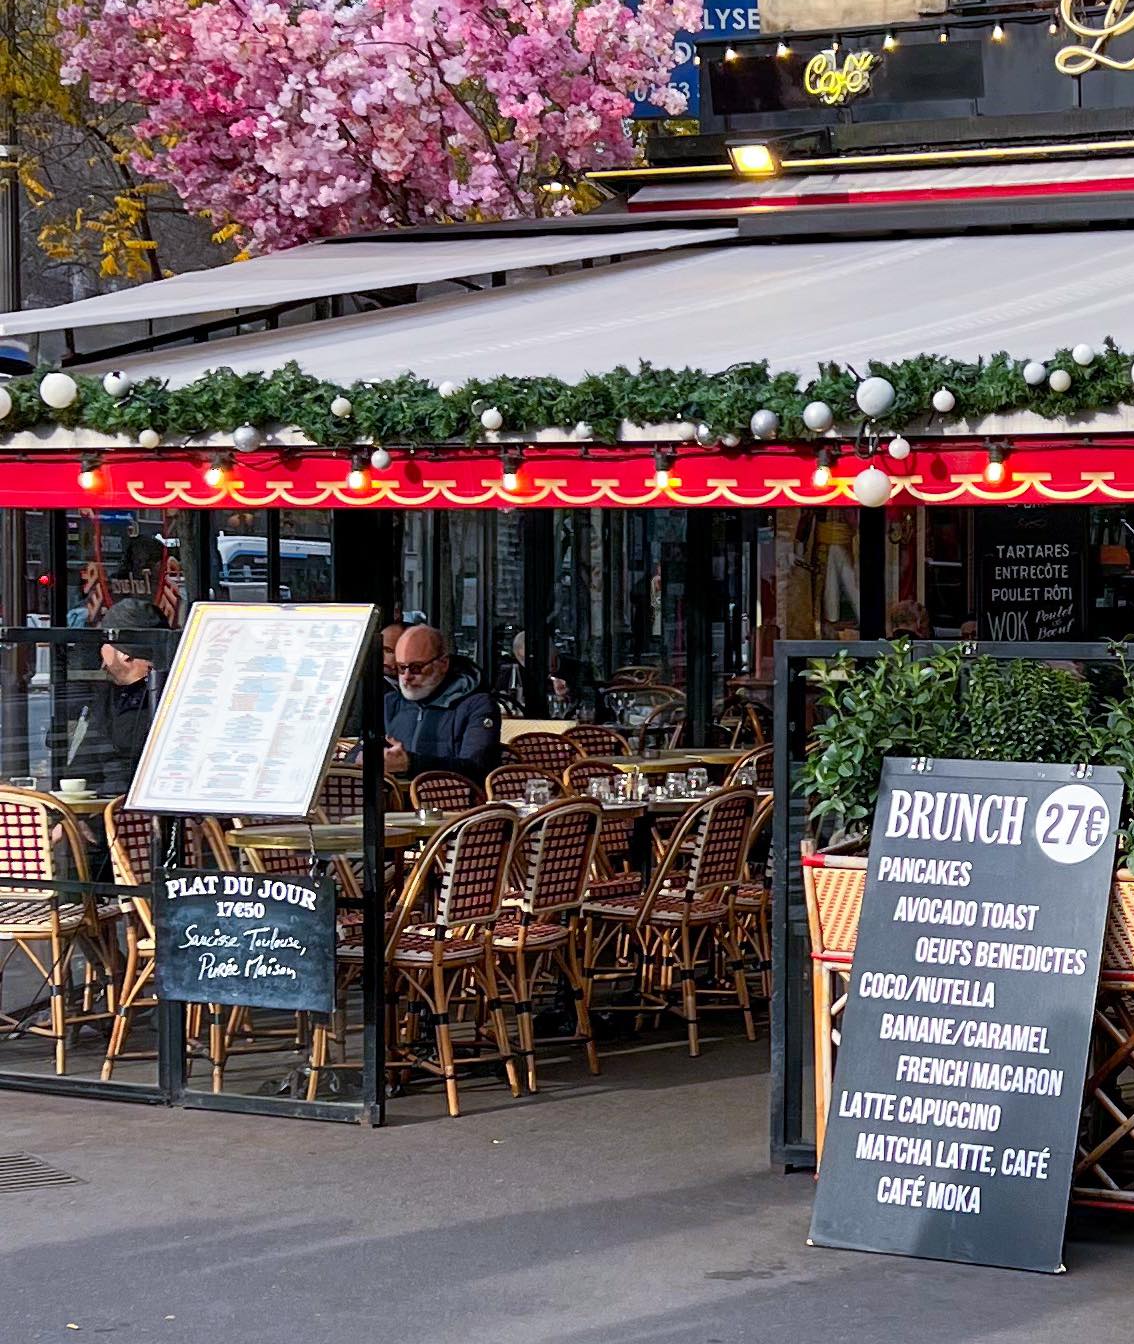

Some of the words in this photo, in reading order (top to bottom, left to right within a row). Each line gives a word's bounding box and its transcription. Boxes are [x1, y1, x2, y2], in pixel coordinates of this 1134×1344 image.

[804, 49, 875, 105] Café
[996, 543, 1070, 559] TARTARES
[994, 562, 1069, 580] ENTRECÔTE
[991, 587, 1040, 602] POULET
[1044, 583, 1073, 601] RÔTI
[987, 609, 1031, 642] WOK
[884, 789, 1029, 846] BRUNCH
[1042, 802, 1107, 847] 27€
[877, 856, 973, 888] PANCAKES
[165, 875, 219, 899] PLAT
[223, 876, 254, 896] DU
[258, 879, 318, 910] JOUR
[215, 901, 266, 918] 17€50
[893, 895, 978, 928] AVOCADO
[981, 901, 1040, 931] TOAST
[244, 954, 297, 980] Maison
[915, 936, 973, 967] OEUFS
[974, 941, 1088, 976] BENEDICTES
[859, 971, 996, 1008] COCO/NUTELLA
[879, 1012, 1051, 1054] BANANE/CARAMEL
[896, 1054, 970, 1088] FRENCH
[970, 1061, 1064, 1097] MACARON
[838, 1090, 897, 1122] LATTE
[898, 1095, 1002, 1133] CAPUCCINO
[855, 1132, 932, 1165] MATCHA
[935, 1140, 997, 1177] LATTE,
[1000, 1146, 1051, 1179] CAFÉ
[876, 1175, 926, 1207] CAFÉ
[926, 1182, 982, 1214] MOKA
